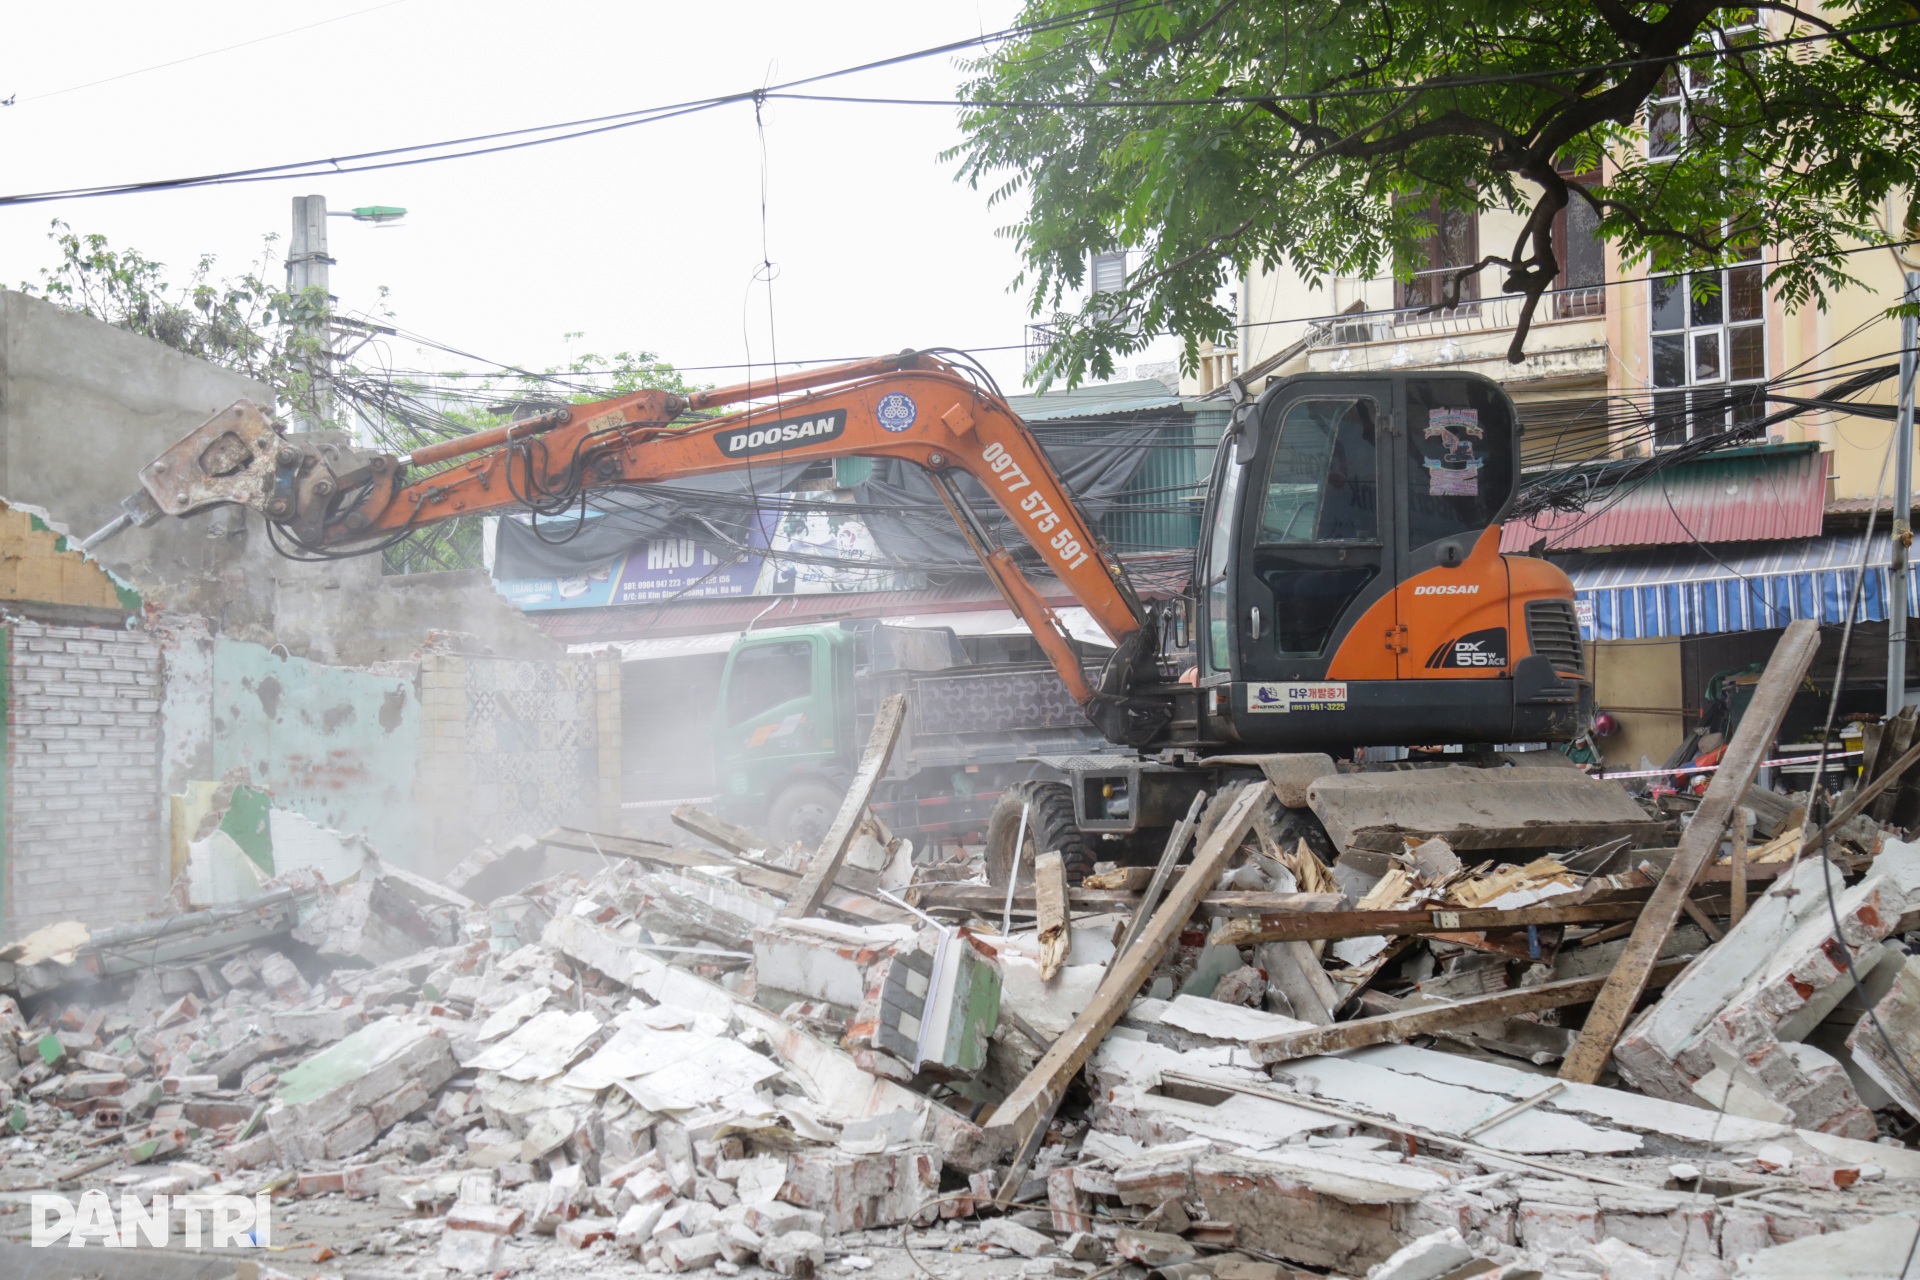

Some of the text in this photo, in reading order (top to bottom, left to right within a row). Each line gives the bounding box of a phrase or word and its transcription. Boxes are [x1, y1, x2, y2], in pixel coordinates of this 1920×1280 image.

[729, 416, 836, 452] DOOSAN
[982, 442, 1089, 570] 0977 575 591
[638, 580, 655, 590] 0904
[656, 579, 668, 588] 947
[669, 578, 681, 587] 223
[648, 591, 661, 599] Kim
[1414, 585, 1479, 595] DOOSAN
[1455, 640, 1486, 652] DX
[1456, 652, 1488, 666] 55
[1488, 657, 1506, 666] ACE
[1289, 688, 1346, 699] 다우개발중기
[1310, 702, 1346, 711] 941-3225
